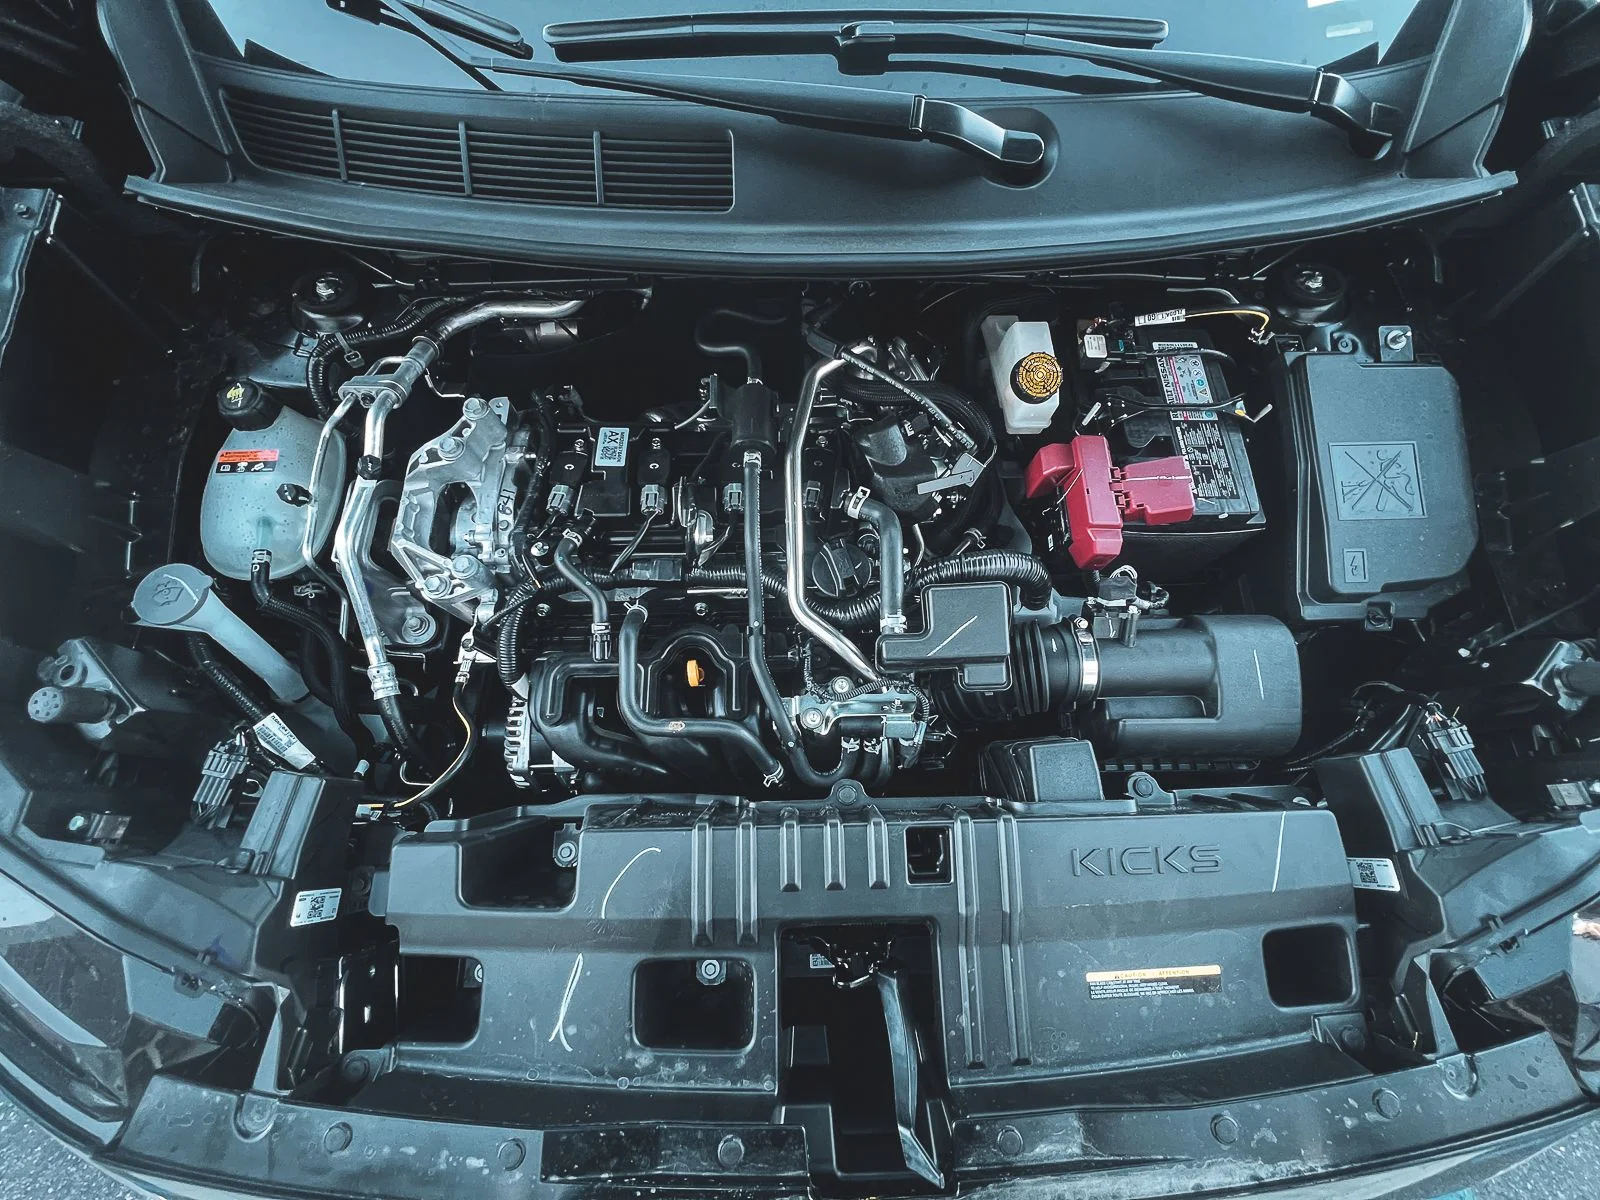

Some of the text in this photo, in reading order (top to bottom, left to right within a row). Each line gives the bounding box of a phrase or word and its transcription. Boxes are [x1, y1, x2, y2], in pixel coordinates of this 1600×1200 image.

[608, 430, 619, 443] AX
[251, 563, 260, 572] D
[1070, 845, 1224, 877] KICKS
